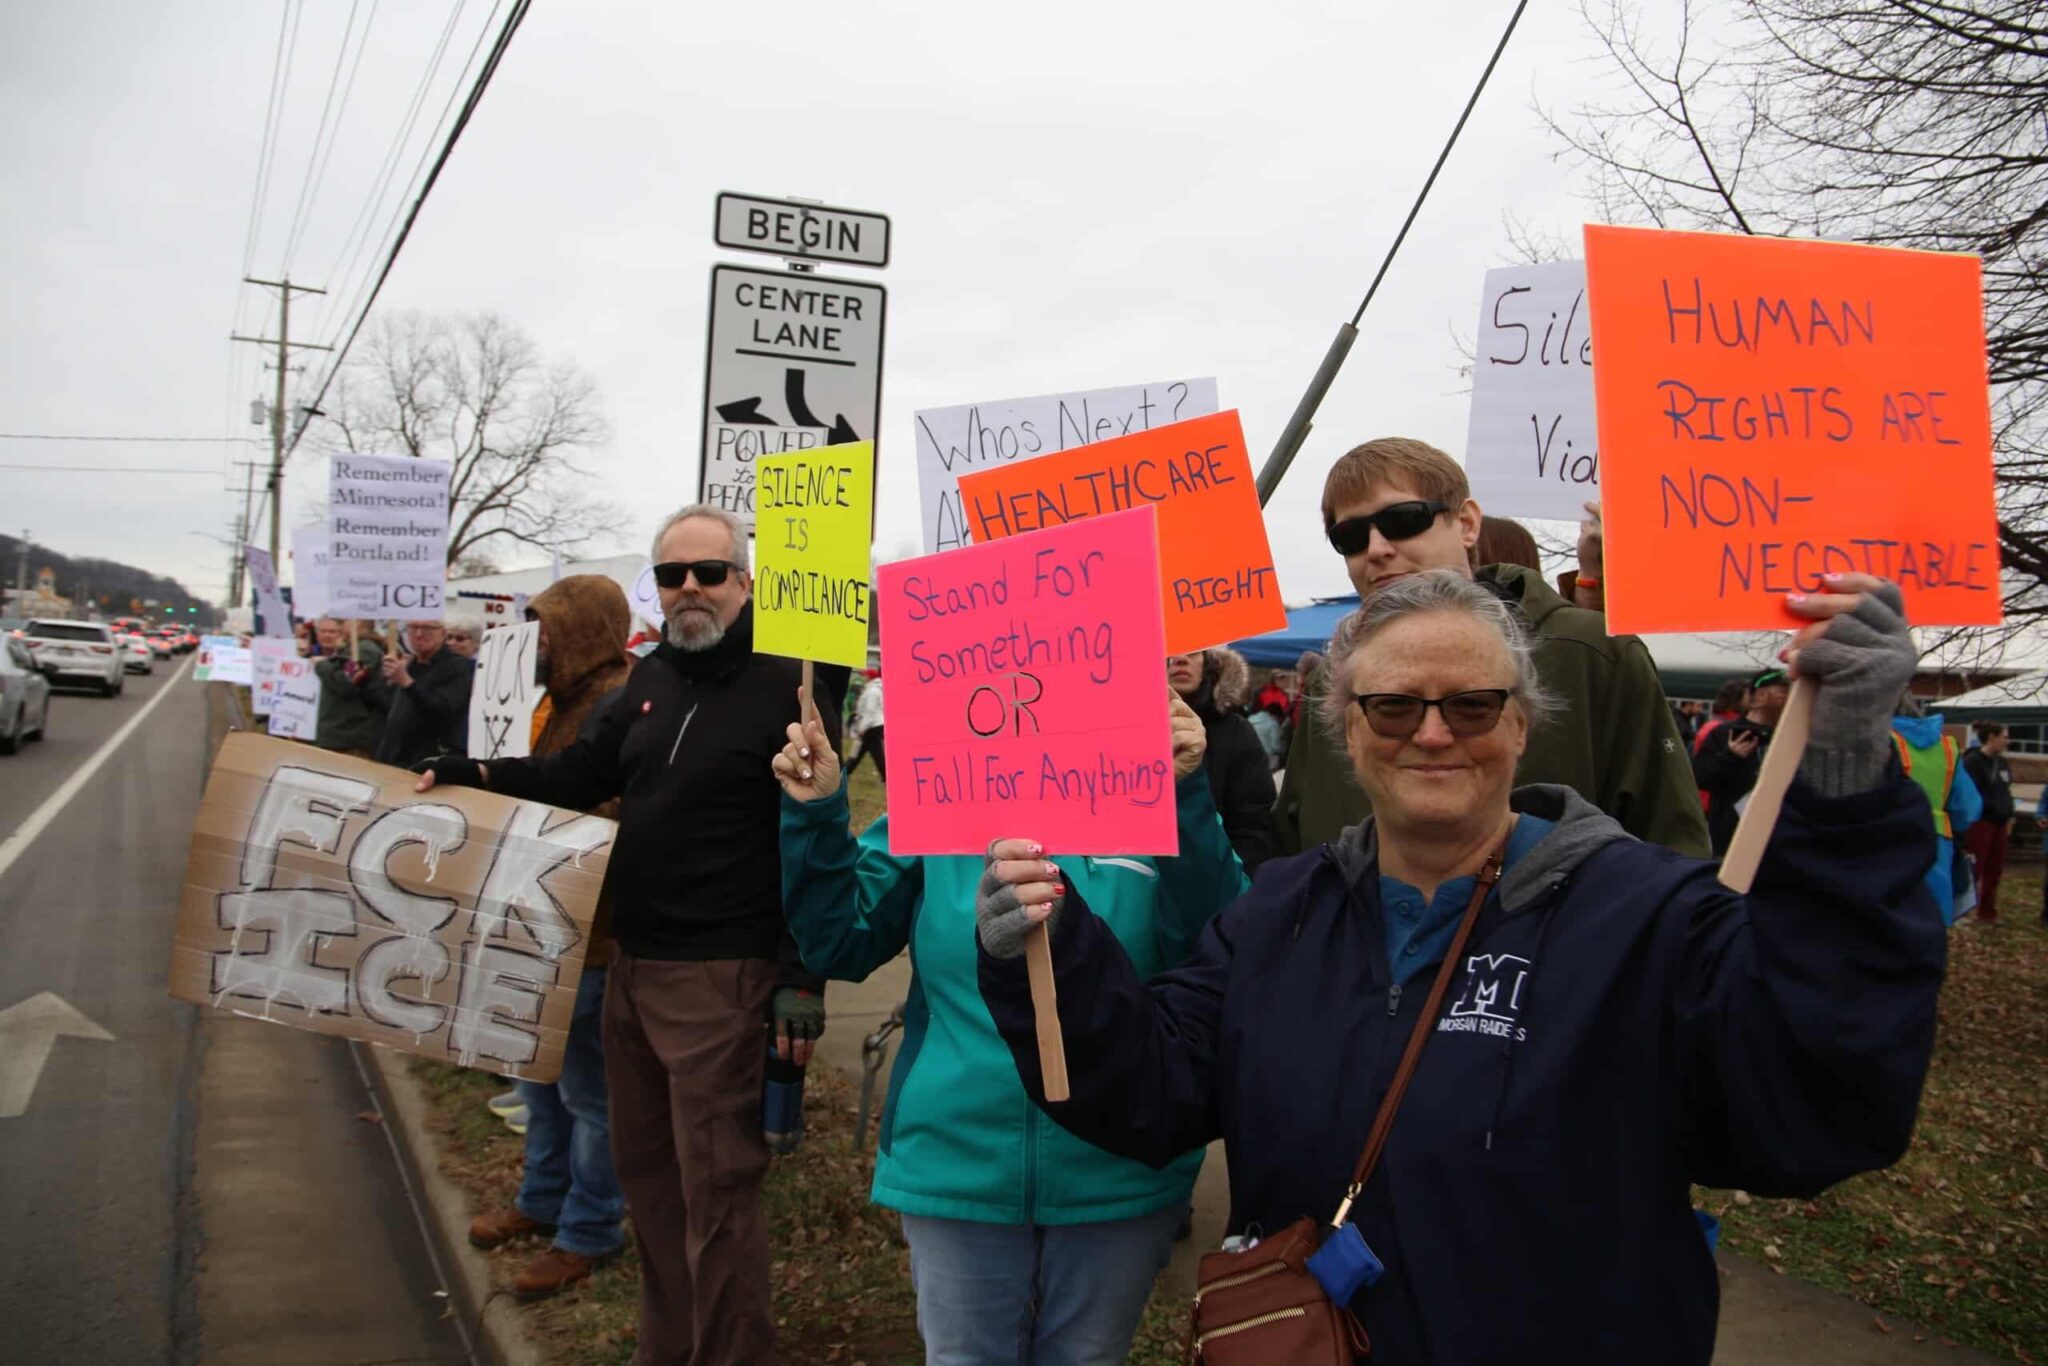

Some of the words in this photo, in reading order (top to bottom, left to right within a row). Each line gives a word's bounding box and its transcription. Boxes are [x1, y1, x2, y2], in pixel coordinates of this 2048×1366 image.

[747, 207, 861, 253] BEGIN
[735, 283, 863, 321] CENTER
[1662, 277, 1875, 354] HUMAN
[752, 318, 842, 352] LANE
[1656, 379, 1854, 443] RIGHTS
[1880, 390, 1962, 445] ARE
[335, 460, 444, 484] Remember
[732, 466, 756, 485] to
[761, 462, 853, 509] SILENCE
[973, 444, 1236, 541] HEALTHCARE
[333, 487, 445, 509] Minnesota!
[1660, 467, 1814, 529] NON-
[333, 541, 429, 561] Portland!
[335, 517, 442, 538] Remember
[784, 516, 809, 552] IS
[380, 583, 441, 609] ICE
[759, 565, 869, 625] COMPLIANCE
[903, 558, 1008, 621] Stand
[1033, 548, 1104, 598] For
[1172, 566, 1276, 613] RIGHT
[911, 616, 1113, 685] Something
[966, 670, 1044, 739] OR
[912, 751, 974, 805] Fall
[984, 754, 1026, 803] For
[1038, 750, 1168, 816] Anything
[239, 765, 614, 961] FCK
[209, 886, 560, 1065] ICE
[1479, 1018, 1527, 1041] RAIDES
